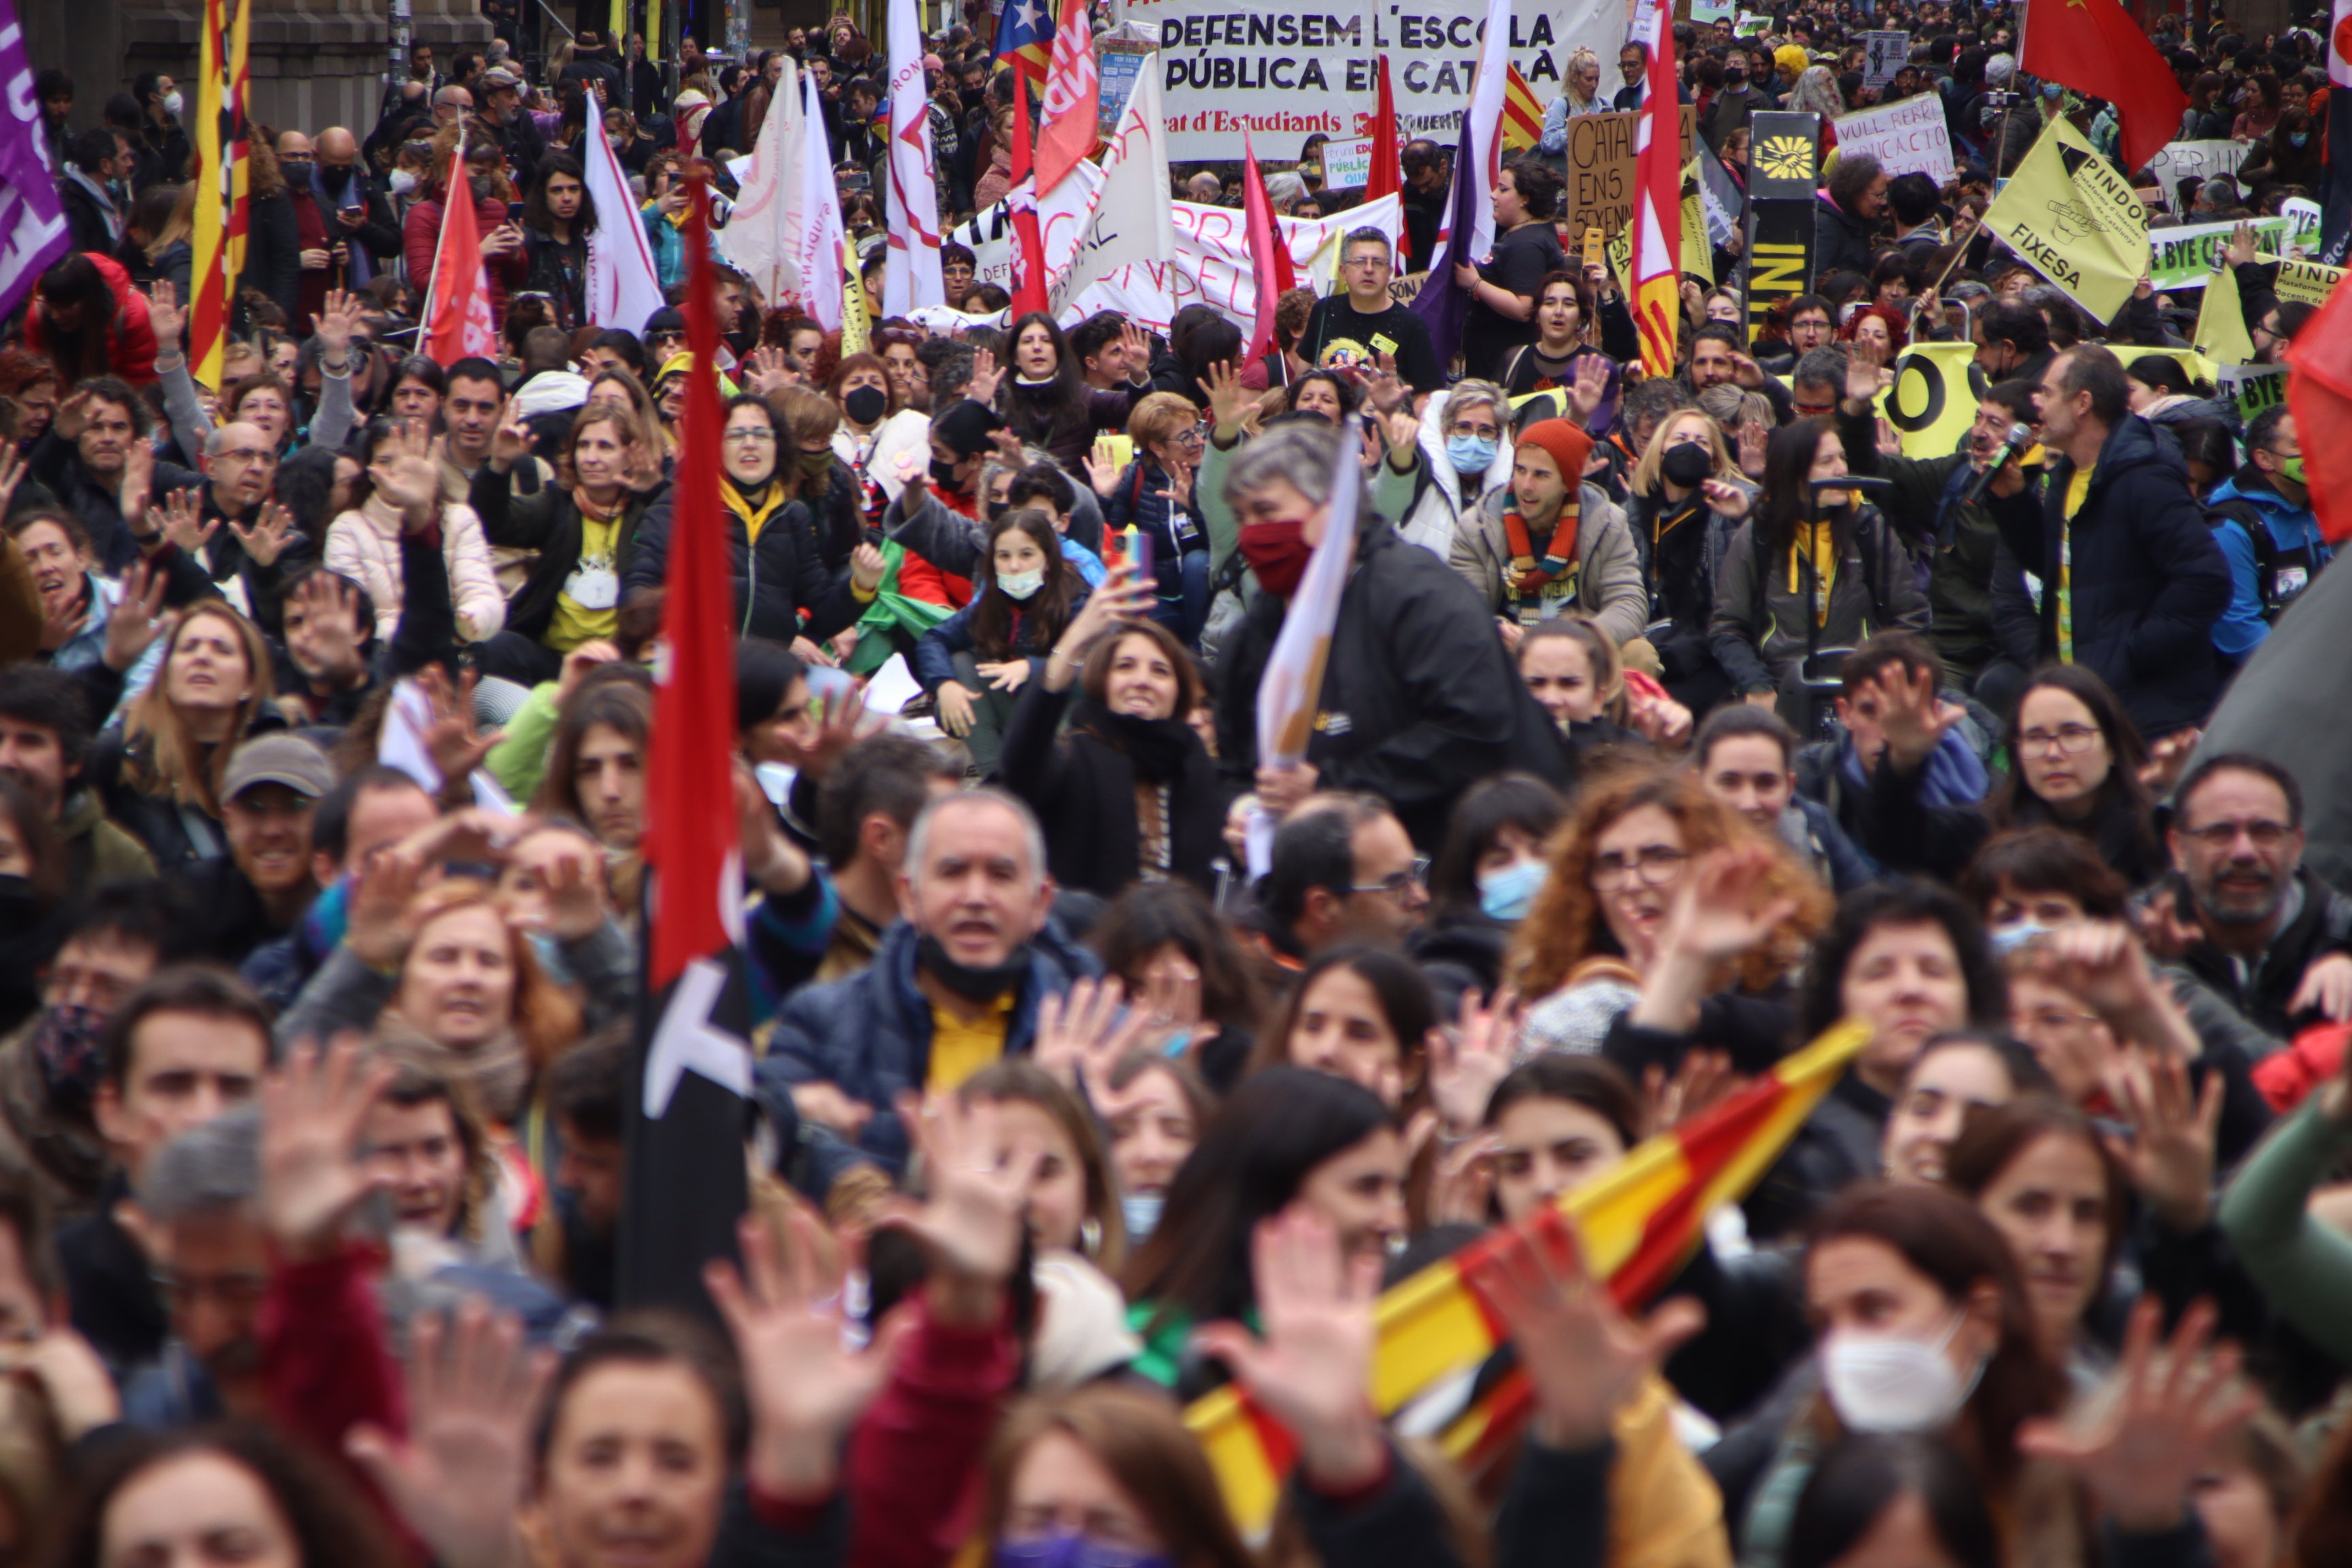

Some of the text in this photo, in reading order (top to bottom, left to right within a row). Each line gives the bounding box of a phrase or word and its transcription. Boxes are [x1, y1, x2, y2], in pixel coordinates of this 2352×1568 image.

[1161, 14, 1361, 49] DEFENSEM
[1166, 48, 1329, 91] PÚBLICA
[1403, 50, 1560, 95] CATLÀ
[1193, 110, 1342, 132] d'Estudiants
[1840, 118, 1885, 141] VULL
[1330, 156, 1368, 173] PÚBLIC
[2153, 150, 2204, 177] PER
[1579, 168, 1623, 205] ENS
[2078, 170, 2109, 207] Plataforma
[2096, 205, 2104, 215] de
[2104, 214, 2137, 247] Catalunya
[2010, 222, 2081, 290] FIXESA
[2165, 238, 2197, 270] BYE
[1387, 279, 1417, 300] SÓN
[2275, 288, 2323, 305] Docents de
[2278, 278, 2323, 295] Plataforma
[2241, 373, 2285, 410] BYE
